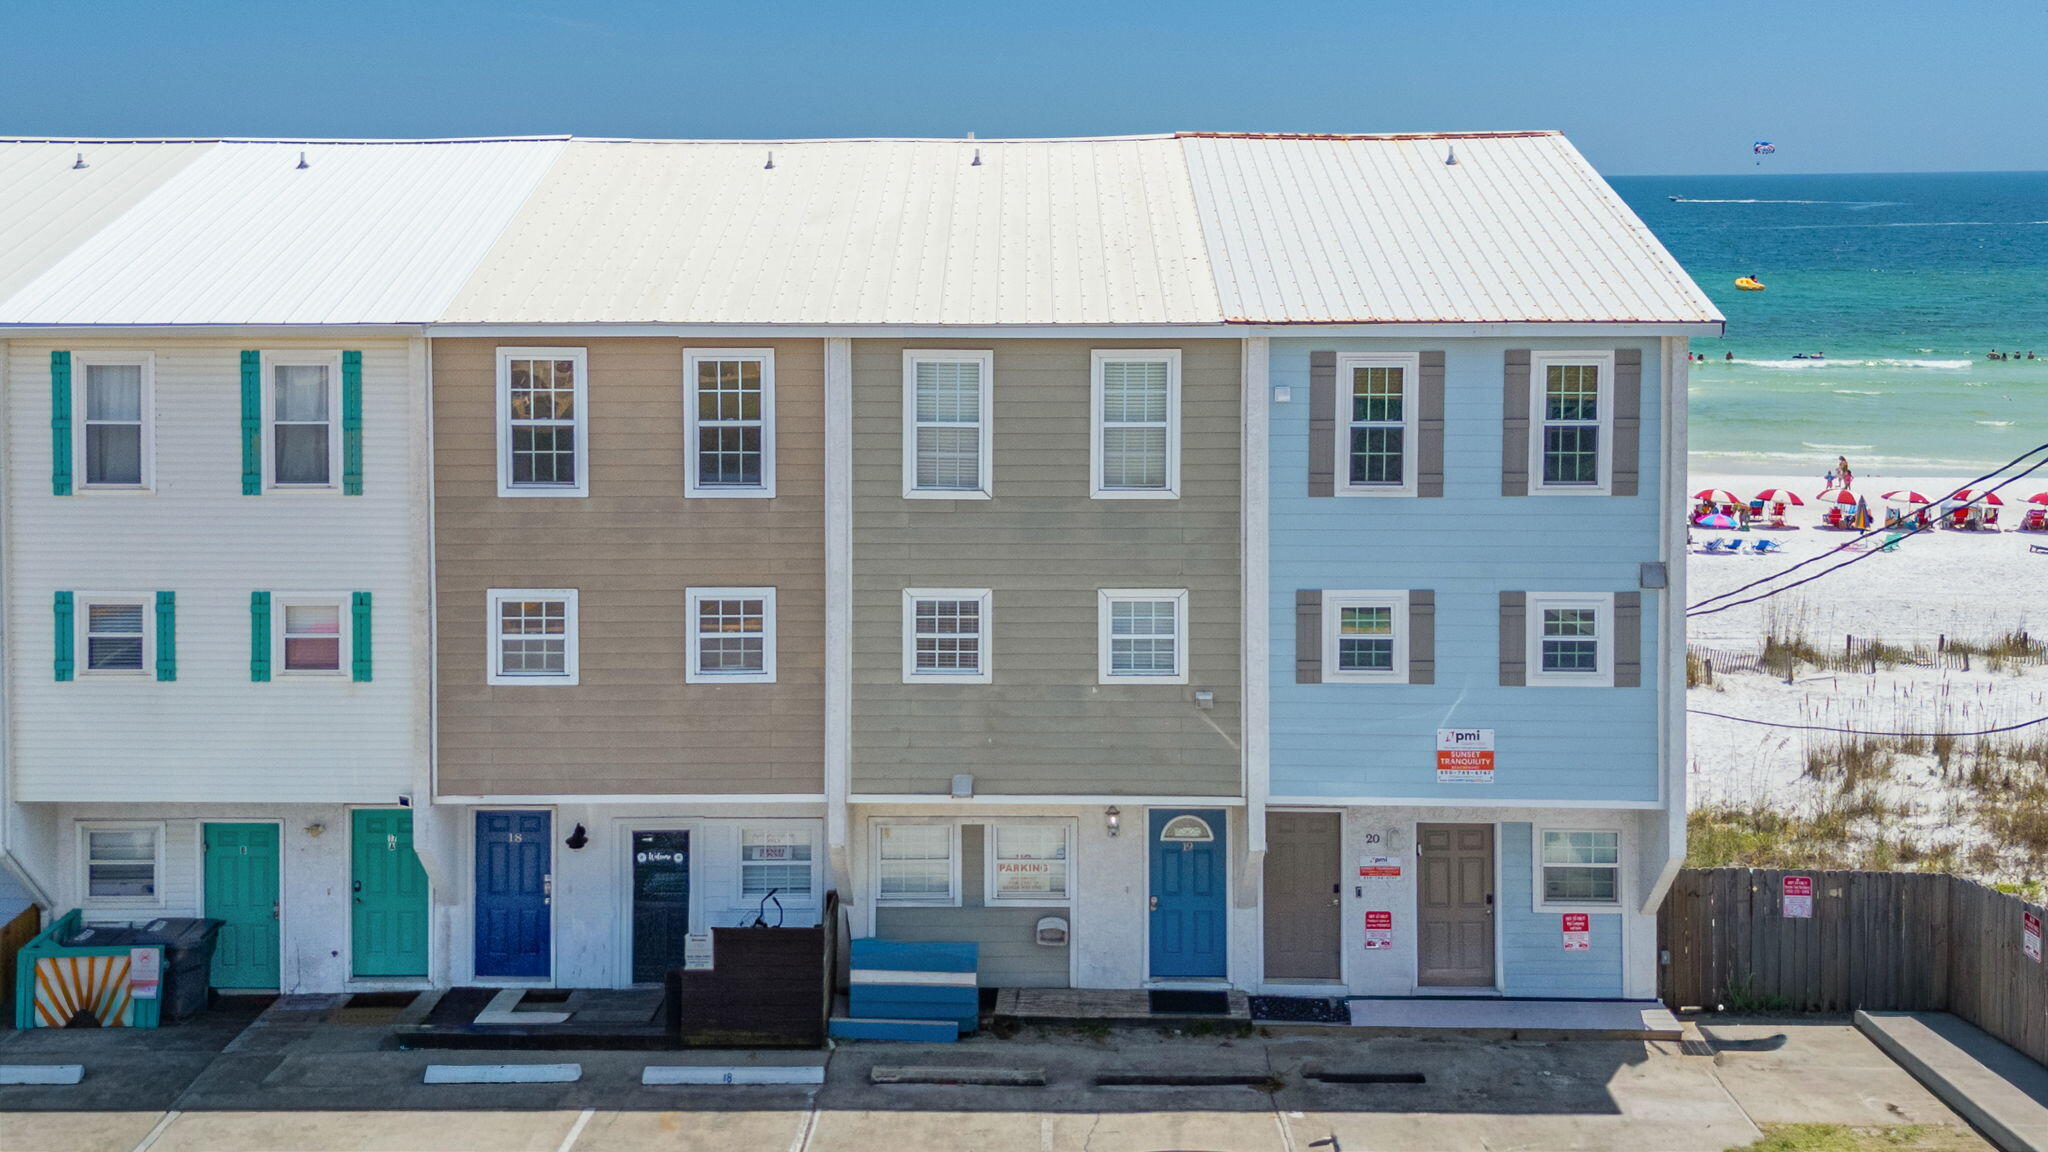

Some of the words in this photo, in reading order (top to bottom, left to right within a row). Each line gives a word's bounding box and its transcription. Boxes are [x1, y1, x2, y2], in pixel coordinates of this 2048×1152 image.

[1456, 730, 1480, 743] pmi
[508, 832, 522, 843] 18
[1366, 833, 1380, 844] 20
[999, 863, 1049, 872] PARKING
[723, 1072, 733, 1083] 18
